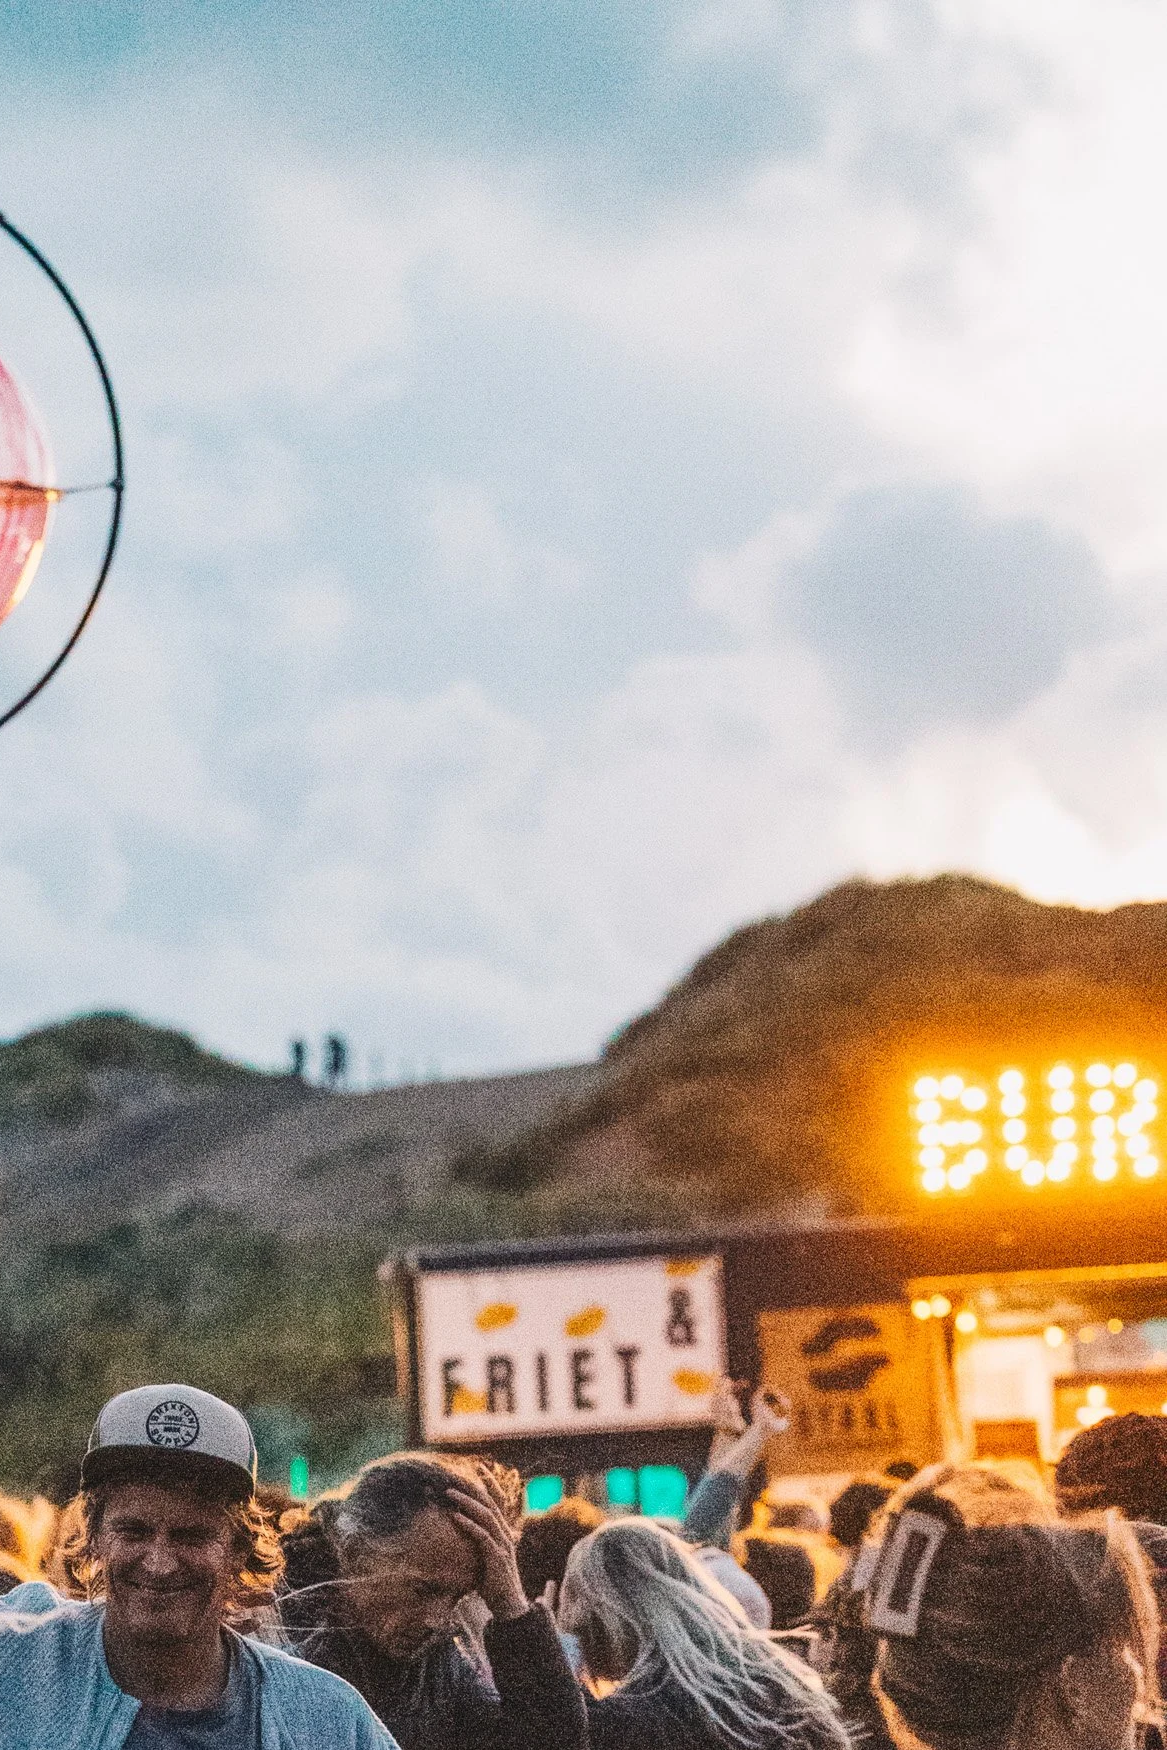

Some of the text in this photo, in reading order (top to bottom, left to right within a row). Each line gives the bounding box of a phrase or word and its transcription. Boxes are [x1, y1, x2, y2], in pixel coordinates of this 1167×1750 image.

[914, 1062, 1160, 1193] BUR
[667, 1287, 695, 1346] &
[442, 1345, 640, 1417] FRIET
[150, 1403, 196, 1424] BRIXTON
[150, 1429, 193, 1446] SUPPLY
